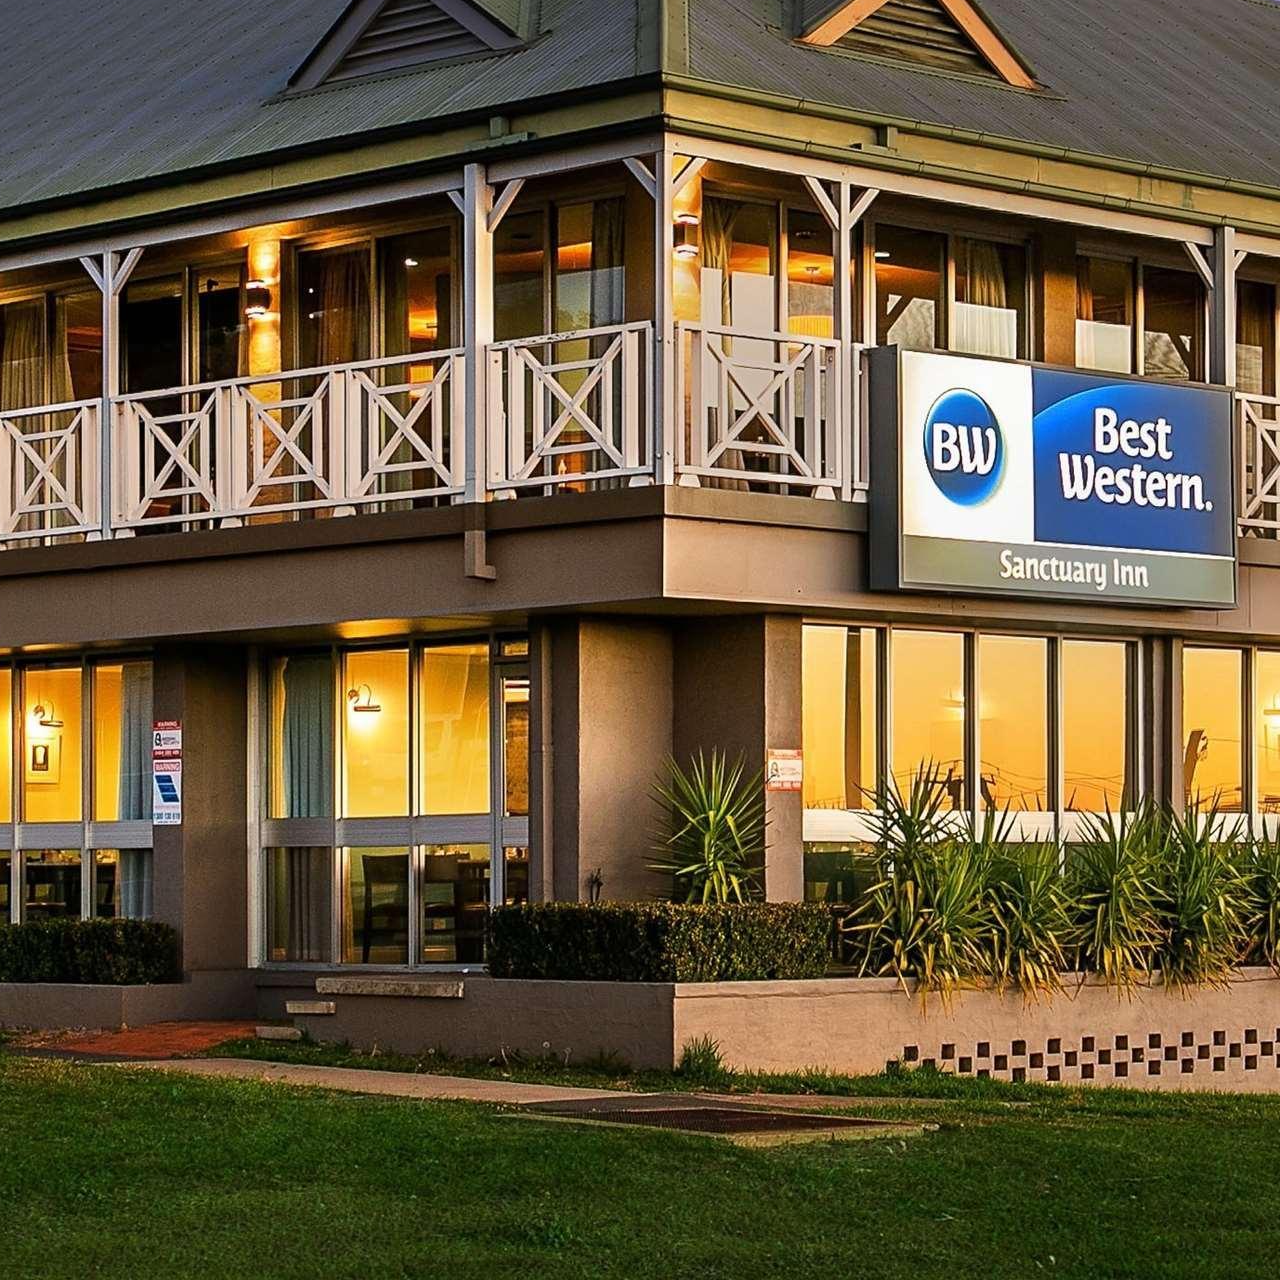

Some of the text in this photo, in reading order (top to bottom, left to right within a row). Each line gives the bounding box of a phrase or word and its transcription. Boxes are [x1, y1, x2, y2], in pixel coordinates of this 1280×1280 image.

[931, 423, 997, 475] BW
[1094, 407, 1173, 460] Best
[999, 549, 1149, 591] Sanctuary Inn
